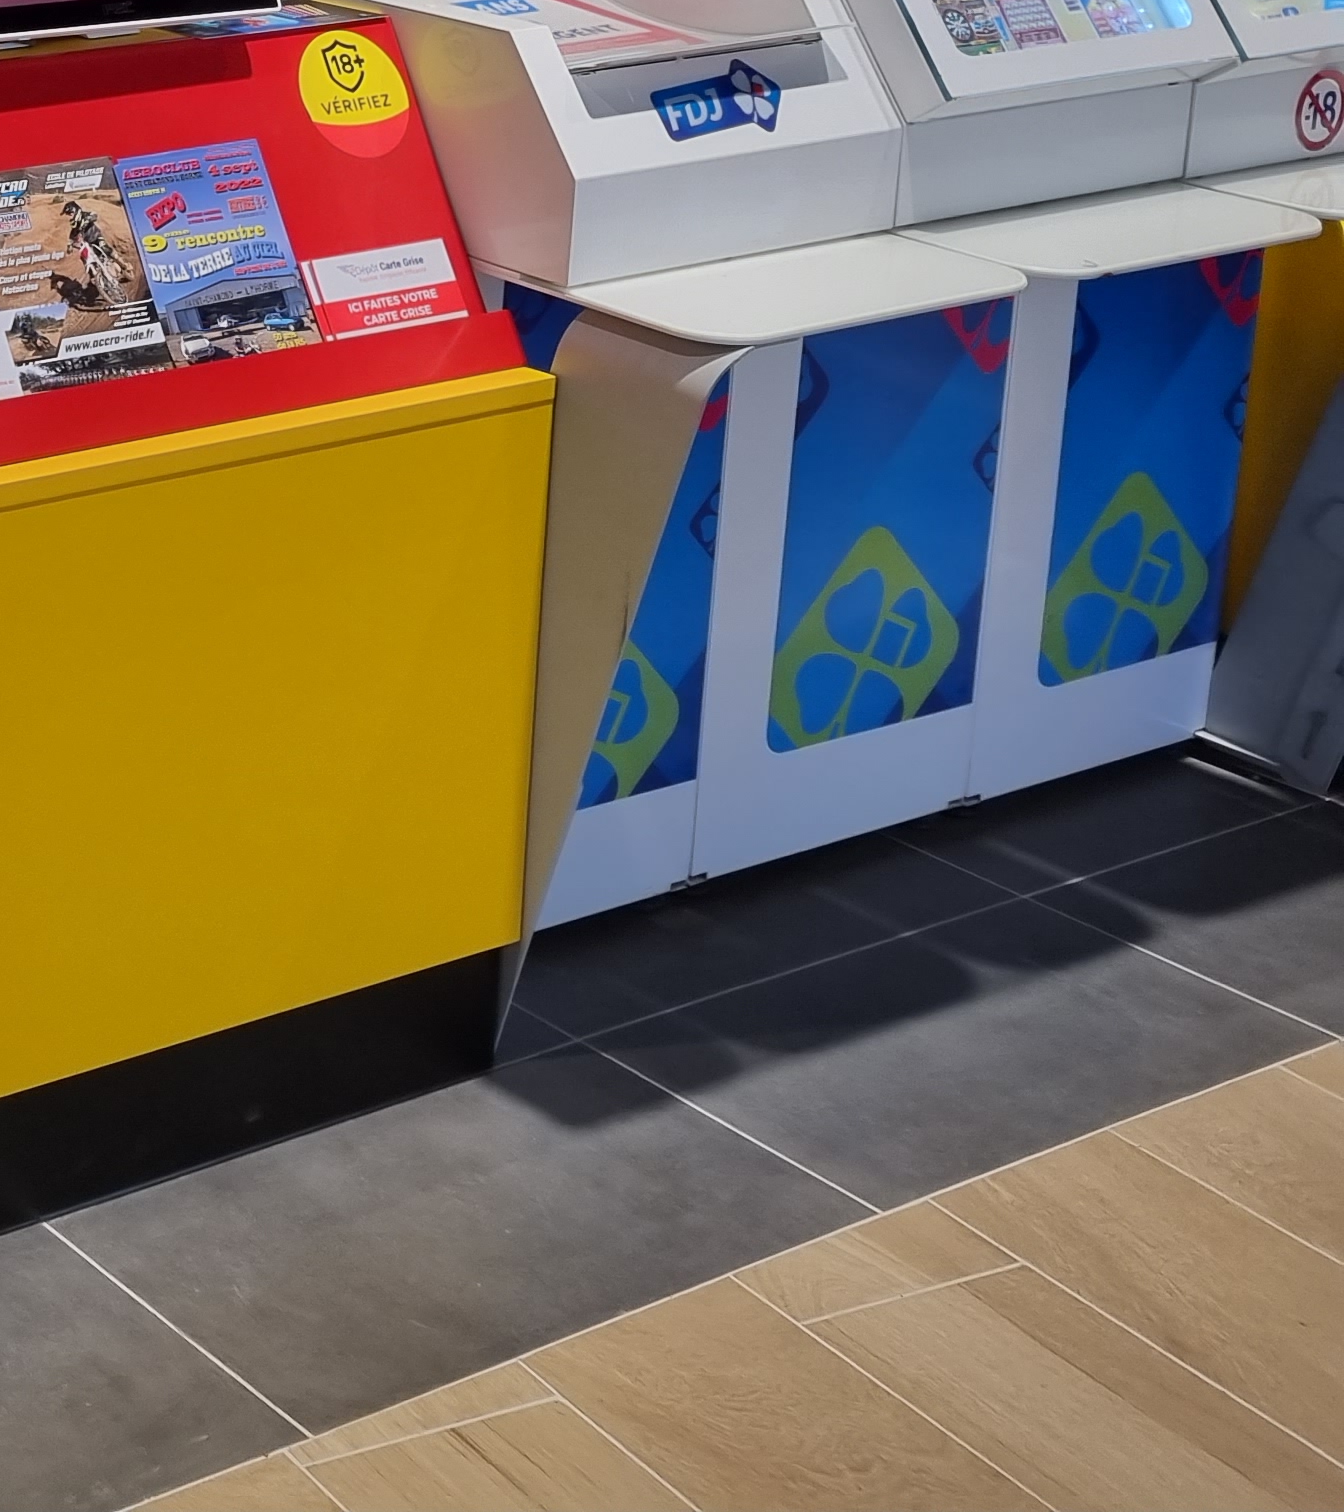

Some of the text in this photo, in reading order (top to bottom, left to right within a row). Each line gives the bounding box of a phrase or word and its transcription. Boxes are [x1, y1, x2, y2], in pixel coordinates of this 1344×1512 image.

[331, 53, 365, 76] 18+
[320, 93, 392, 116] VÉRIFIEZ
[666, 91, 724, 132] FDJ
[1305, 91, 1337, 130] -18
[75, 167, 105, 178] PILOTAGE
[123, 158, 201, 180] AEROCLUB
[208, 160, 259, 177] 4 sept
[214, 177, 264, 193] 2022
[145, 190, 187, 228] EXPO
[175, 225, 265, 250] rencontre
[148, 263, 172, 283] DE
[171, 263, 191, 283] LA
[187, 248, 235, 279] TERRE
[234, 243, 253, 264] AU
[252, 241, 286, 260] CIEL
[379, 256, 424, 271] Carte Grise
[347, 288, 439, 314] ICI FAITES VOTRE
[363, 304, 434, 326] CARTE GRISE
[65, 328, 155, 353] www.accro-ride.fr
